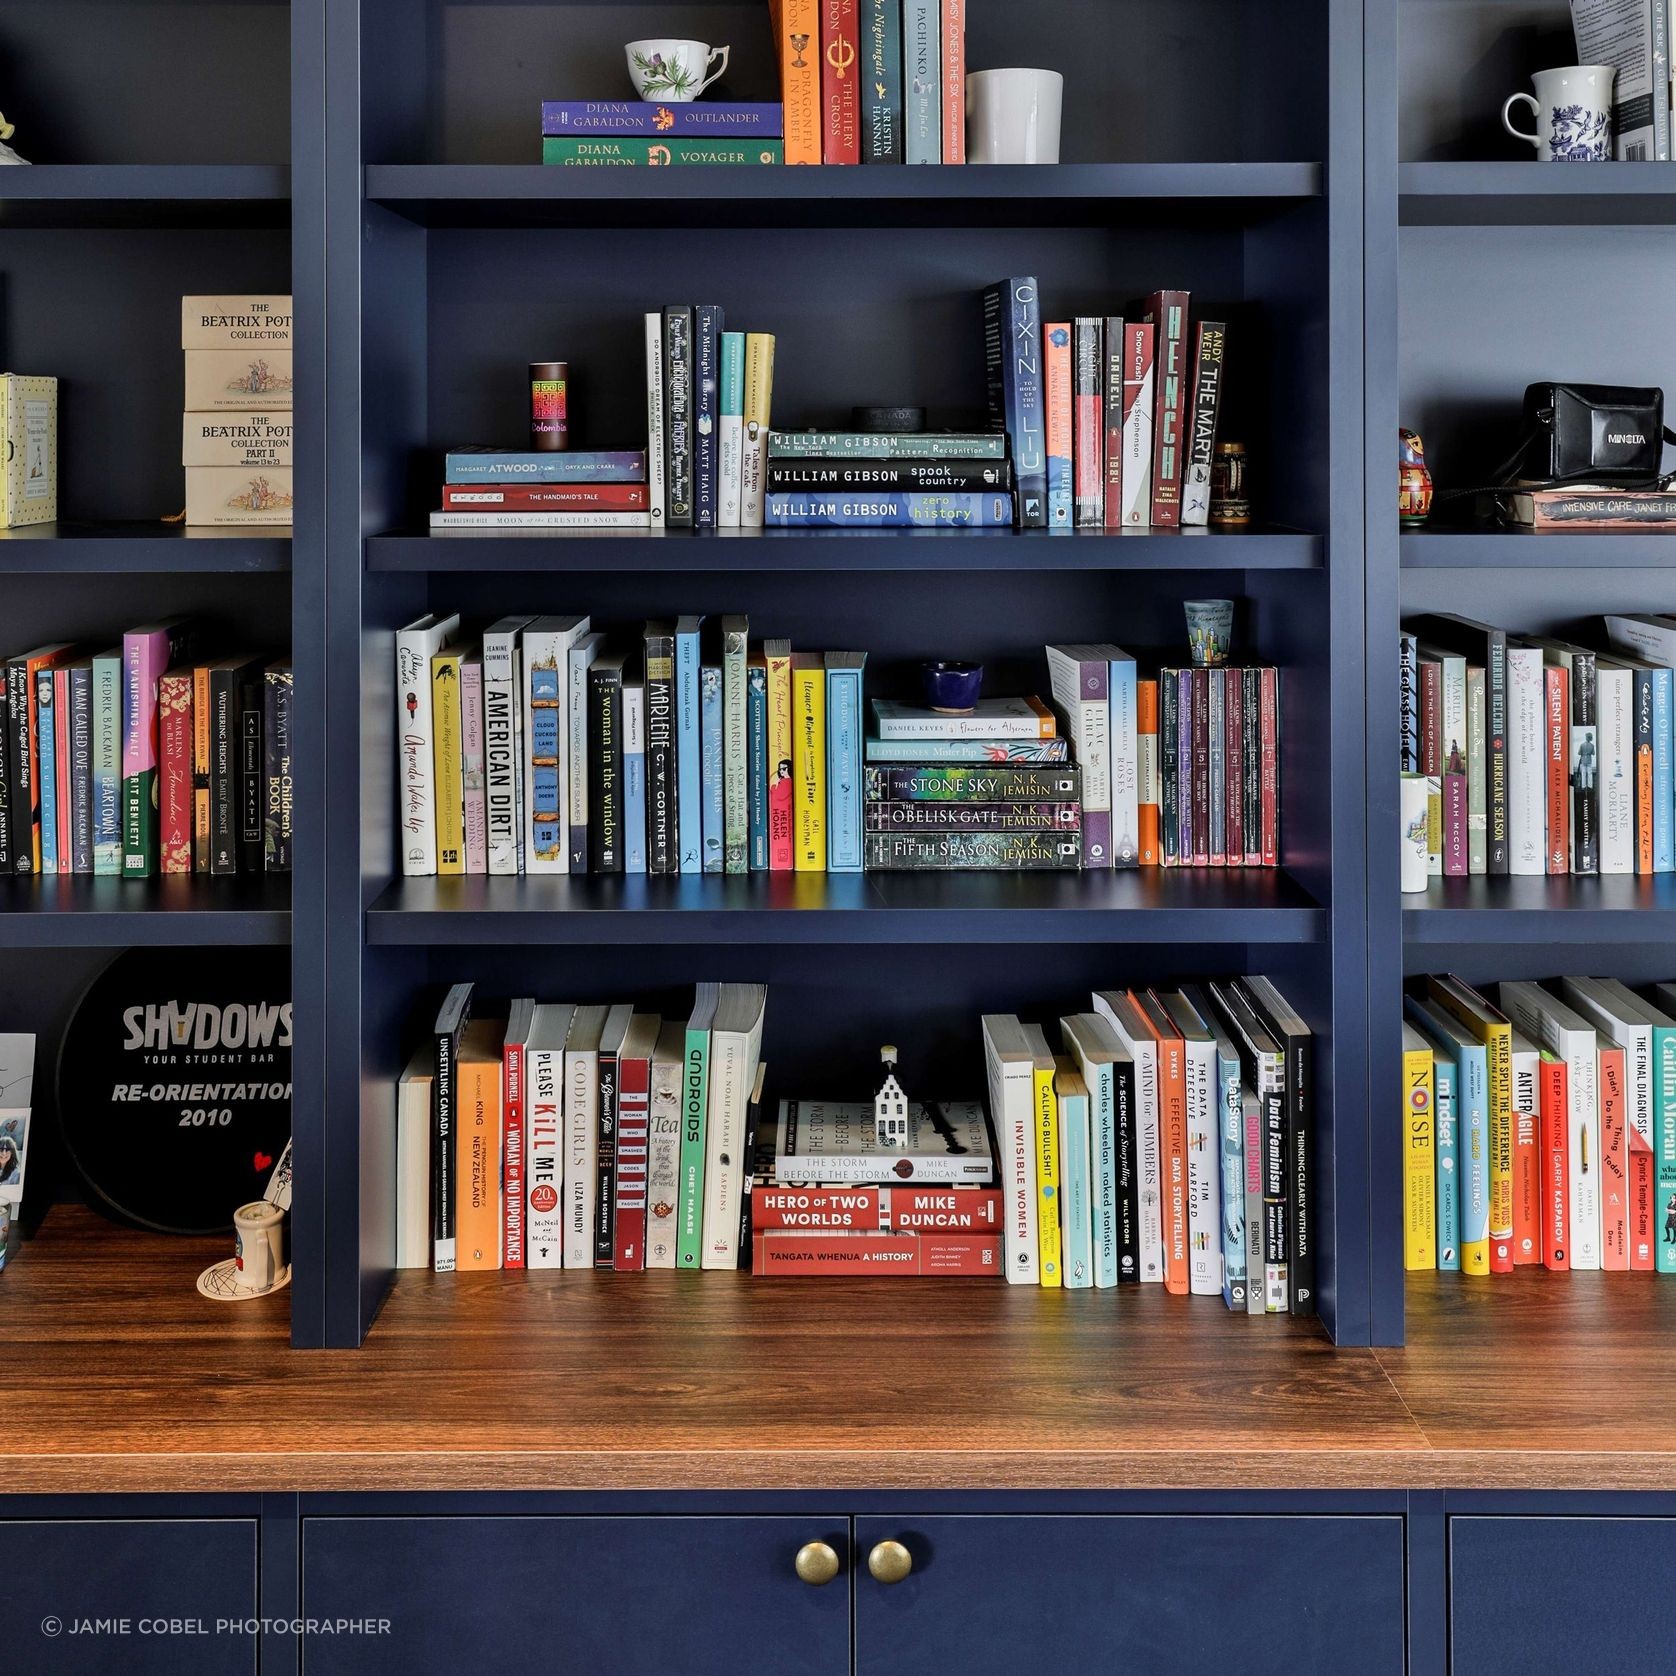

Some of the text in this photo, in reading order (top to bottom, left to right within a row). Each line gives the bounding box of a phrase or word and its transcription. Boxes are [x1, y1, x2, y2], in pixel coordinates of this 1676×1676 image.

[872, 13, 887, 76] Nightingale
[917, 7, 927, 75] PACHINKO
[586, 104, 628, 114] DIANA
[685, 113, 760, 123] OUTLANDER
[832, 96, 841, 136] CROSS
[842, 81, 853, 150] THE FIERY
[573, 115, 644, 128] GABALDON
[873, 106, 881, 157] HANNAH
[882, 107, 892, 154] KRISTIN
[578, 144, 621, 155] DIANA
[680, 152, 744, 163] VOYAGER
[202, 316, 292, 327] BEATRIX POT
[231, 331, 288, 339] COLLECTION
[700, 316, 710, 377] The Midnight
[1202, 332, 1212, 361] WEIR
[1214, 331, 1223, 363] ANDY
[1111, 356, 1120, 409] ORWELL
[1162, 306, 1180, 479] HENCH
[202, 426, 292, 437] BEATRIX POT
[251, 417, 269, 425] THE
[532, 422, 567, 433] Colombia
[775, 435, 897, 448] WILLIAM GIBSON
[1608, 434, 1645, 443] MINOLTA
[489, 463, 537, 473] ATWOOD
[775, 470, 897, 481] WILLIAM GIBSON
[911, 465, 950, 477] spook
[1110, 455, 1118, 483] 1984
[919, 475, 966, 487] country
[772, 504, 897, 515] WILLIAM GIBSON
[922, 496, 948, 506] zero
[1562, 501, 1661, 513] INTENSIVE CARE JANET
[914, 507, 971, 520] history
[76, 690, 87, 707] MAN
[130, 646, 139, 756] THE VANISHING HALF
[103, 672, 112, 768] FREDRIK BACKMAN
[651, 685, 669, 748] MARLENE
[1552, 688, 1561, 761] SILENT PATIENT
[76, 711, 87, 746] CALLED
[218, 691, 227, 774] WUTHERING HEIGHTS
[76, 747, 87, 770] OVE
[488, 690, 511, 836] AMERICAN DIRT
[603, 697, 615, 847] woman in the window
[910, 779, 998, 792] STONE SKY
[1004, 785, 1050, 796] JEMISIN
[1494, 753, 1503, 841] HURRICANE SEASON
[103, 777, 114, 834] BEARTOWN
[130, 771, 138, 846] BRIT BENNETT
[892, 810, 998, 823] OBELISK GATE
[656, 790, 665, 848] GORTNER
[1003, 815, 1051, 826] JEMISIN
[895, 844, 999, 857] FIFTH SEASON
[1004, 848, 1052, 859] JEMISIN
[145, 1056, 176, 1064] YOUR
[252, 1055, 274, 1063] BAR
[1637, 1058, 1646, 1080] FINAL
[440, 1038, 448, 1136] UNSETTLING CANADA
[538, 1054, 552, 1097] PLEASE
[179, 1110, 232, 1126] 2010
[575, 1060, 585, 1166] CODE GIRLS
[1518, 1071, 1532, 1146] ANTIFRAGILE
[1638, 1083, 1647, 1134] DIAGNOSIS
[651, 1116, 678, 1133] Tea
[1171, 1098, 1180, 1154] EFFECTIVE
[508, 1130, 518, 1166] WOMAN
[1042, 1131, 1052, 1178] BULLSHIT
[1247, 1116, 1260, 1192] GOOD CHARTS
[1269, 1097, 1280, 1194] Data Feminism
[509, 1168, 517, 1177] OF
[536, 1158, 552, 1181] ME
[508, 1179, 518, 1193] NO
[765, 1197, 868, 1208] HERO OF TWO
[915, 1197, 956, 1209] MIKE
[1017, 1190, 1026, 1238] WOMEN
[507, 1196, 520, 1261] IMPORTANCE
[782, 1214, 852, 1225] WORLDS
[900, 1215, 970, 1225] DUNCAN
[1174, 1187, 1182, 1259] STORYTELLING
[771, 1253, 814, 1261] TANGATA
